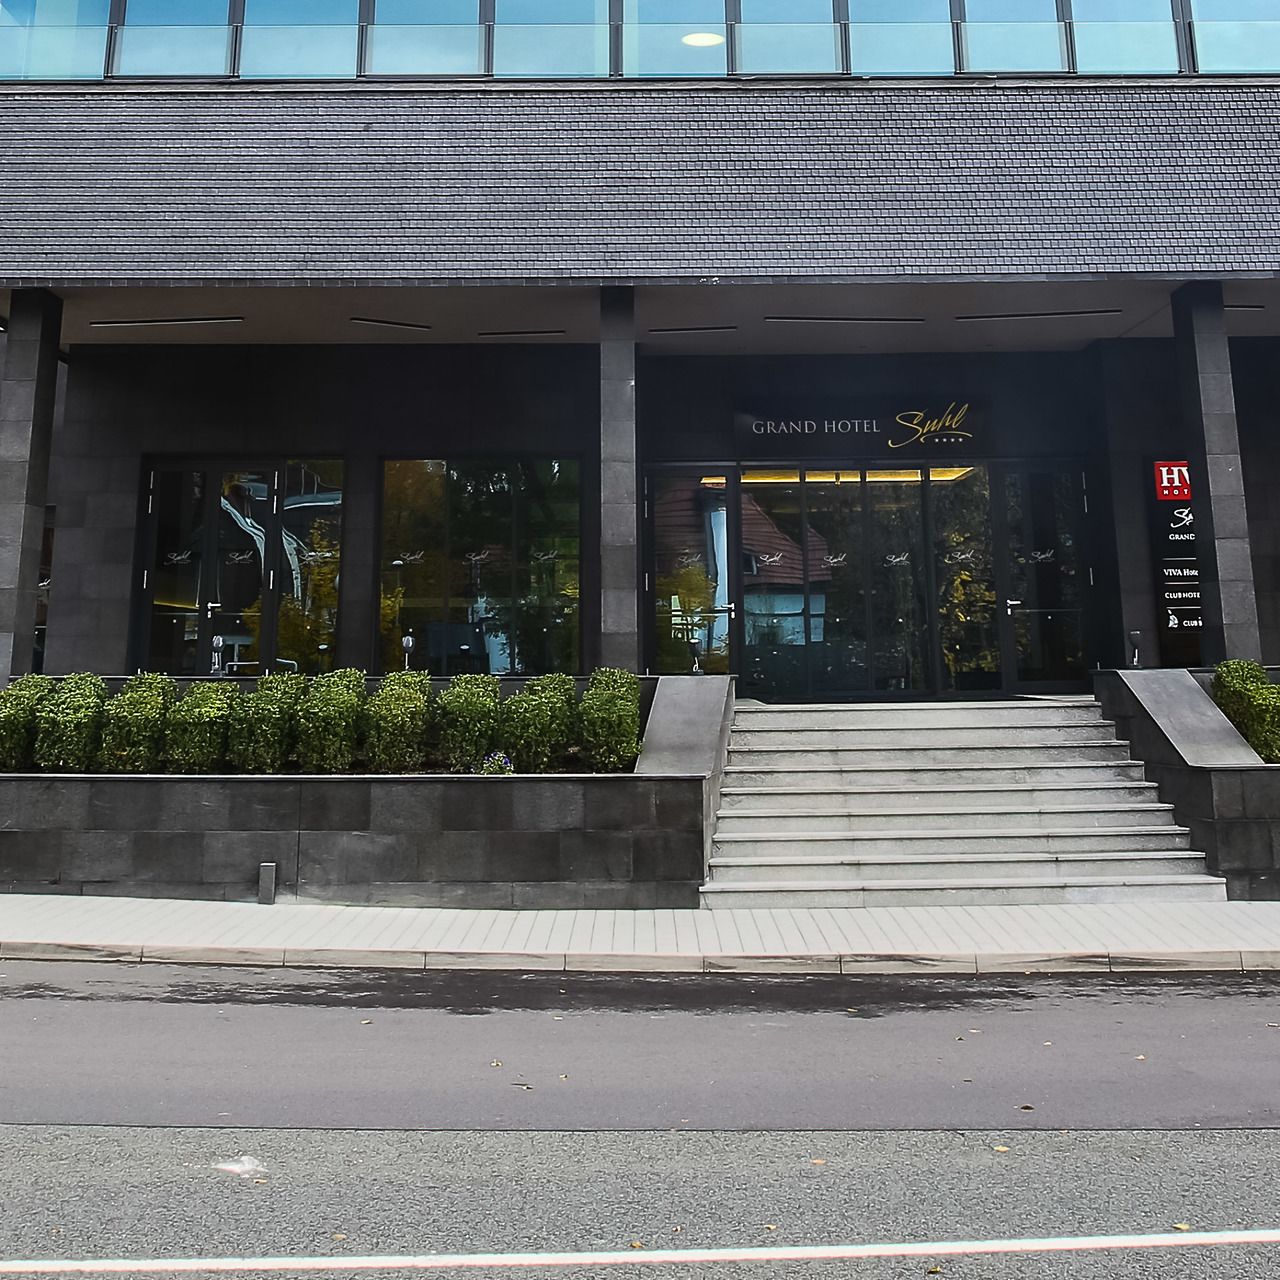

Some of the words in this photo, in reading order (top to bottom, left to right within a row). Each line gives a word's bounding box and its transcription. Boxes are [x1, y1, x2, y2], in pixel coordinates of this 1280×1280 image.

[752, 419, 817, 434] GRAND
[824, 419, 881, 434] HOTEL
[888, 402, 969, 448] Suhl
[1163, 568, 1183, 576] VIVA
